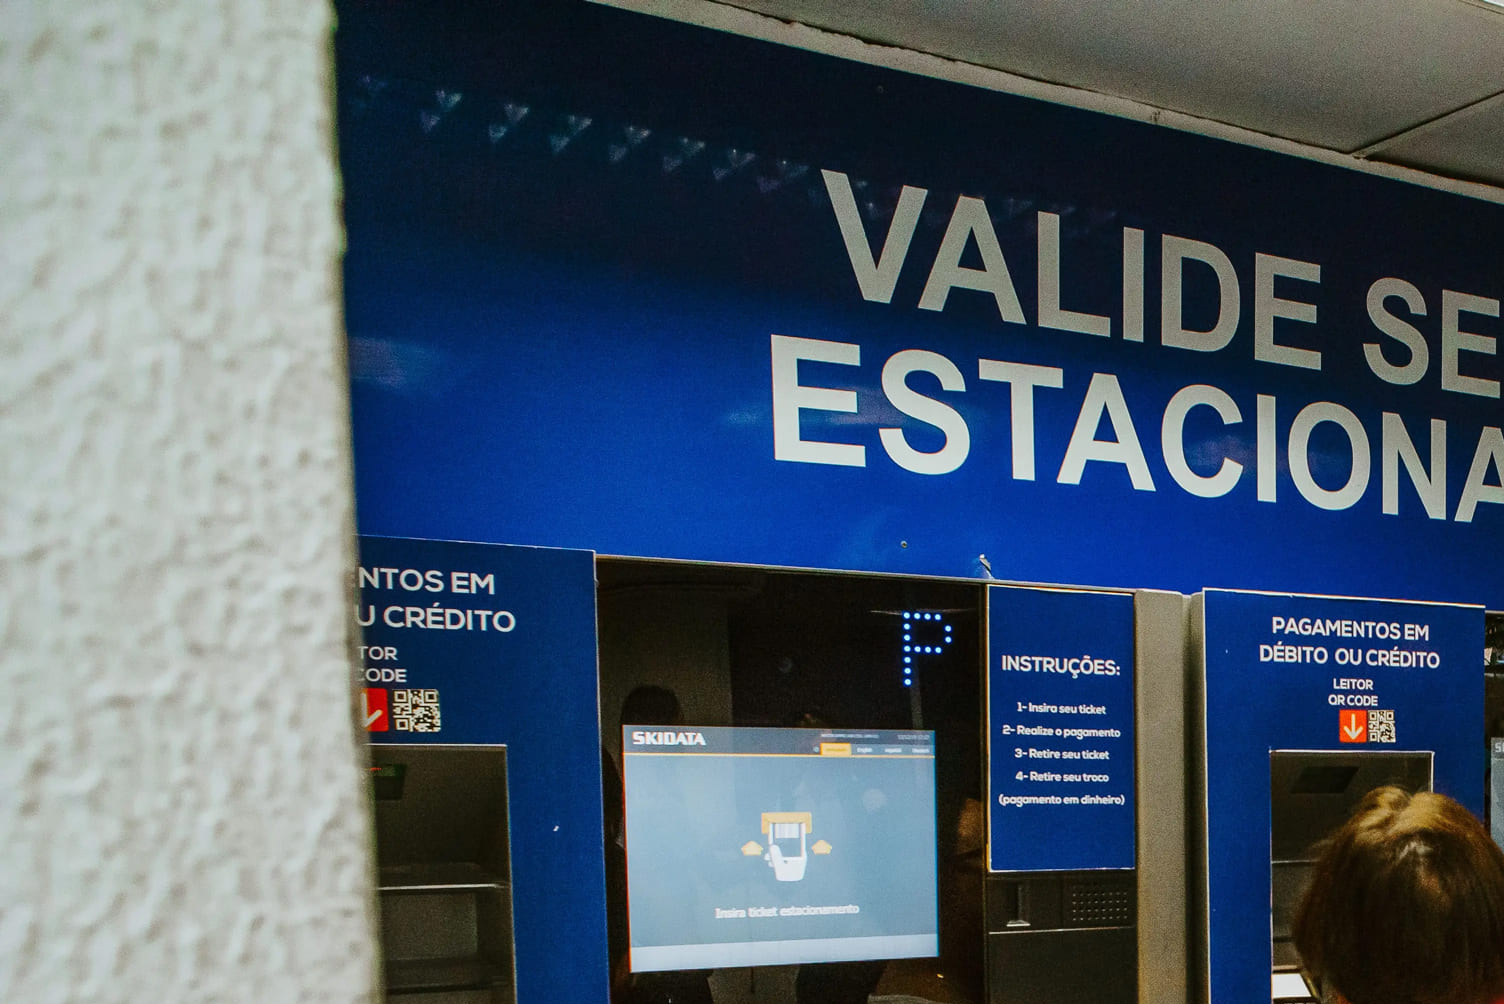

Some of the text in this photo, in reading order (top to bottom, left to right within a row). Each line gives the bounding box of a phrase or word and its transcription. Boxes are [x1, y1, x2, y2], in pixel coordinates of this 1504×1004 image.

[820, 168, 1323, 371] VALIDE
[451, 571, 496, 595] EM
[383, 602, 517, 633] CRÉDITO
[1272, 616, 1430, 641] PAGAMENTOS EM
[903, 611, 952, 687] P
[1259, 640, 1441, 669] DÉBITO OU CRÉDITO
[1001, 655, 1121, 679] INSTRUÇÕES:
[1332, 678, 1374, 691] LEITOR
[1328, 694, 1378, 707] QR CODE
[1029, 702, 1057, 713] Insira
[1059, 705, 1078, 714] seu
[1079, 704, 1106, 715] ticket
[632, 731, 707, 746] SKIDATA
[1017, 725, 1054, 736] Realize
[1055, 728, 1062, 736] o
[1063, 728, 1121, 740] pagamento
[1029, 748, 1060, 759] Retire
[1062, 751, 1080, 760] seu
[1081, 750, 1109, 760] ticket
[1030, 771, 1061, 782] Retire
[1063, 774, 1081, 782] seu
[1082, 773, 1109, 783] troco
[998, 794, 1126, 808] (pagamento em dinheiro)
